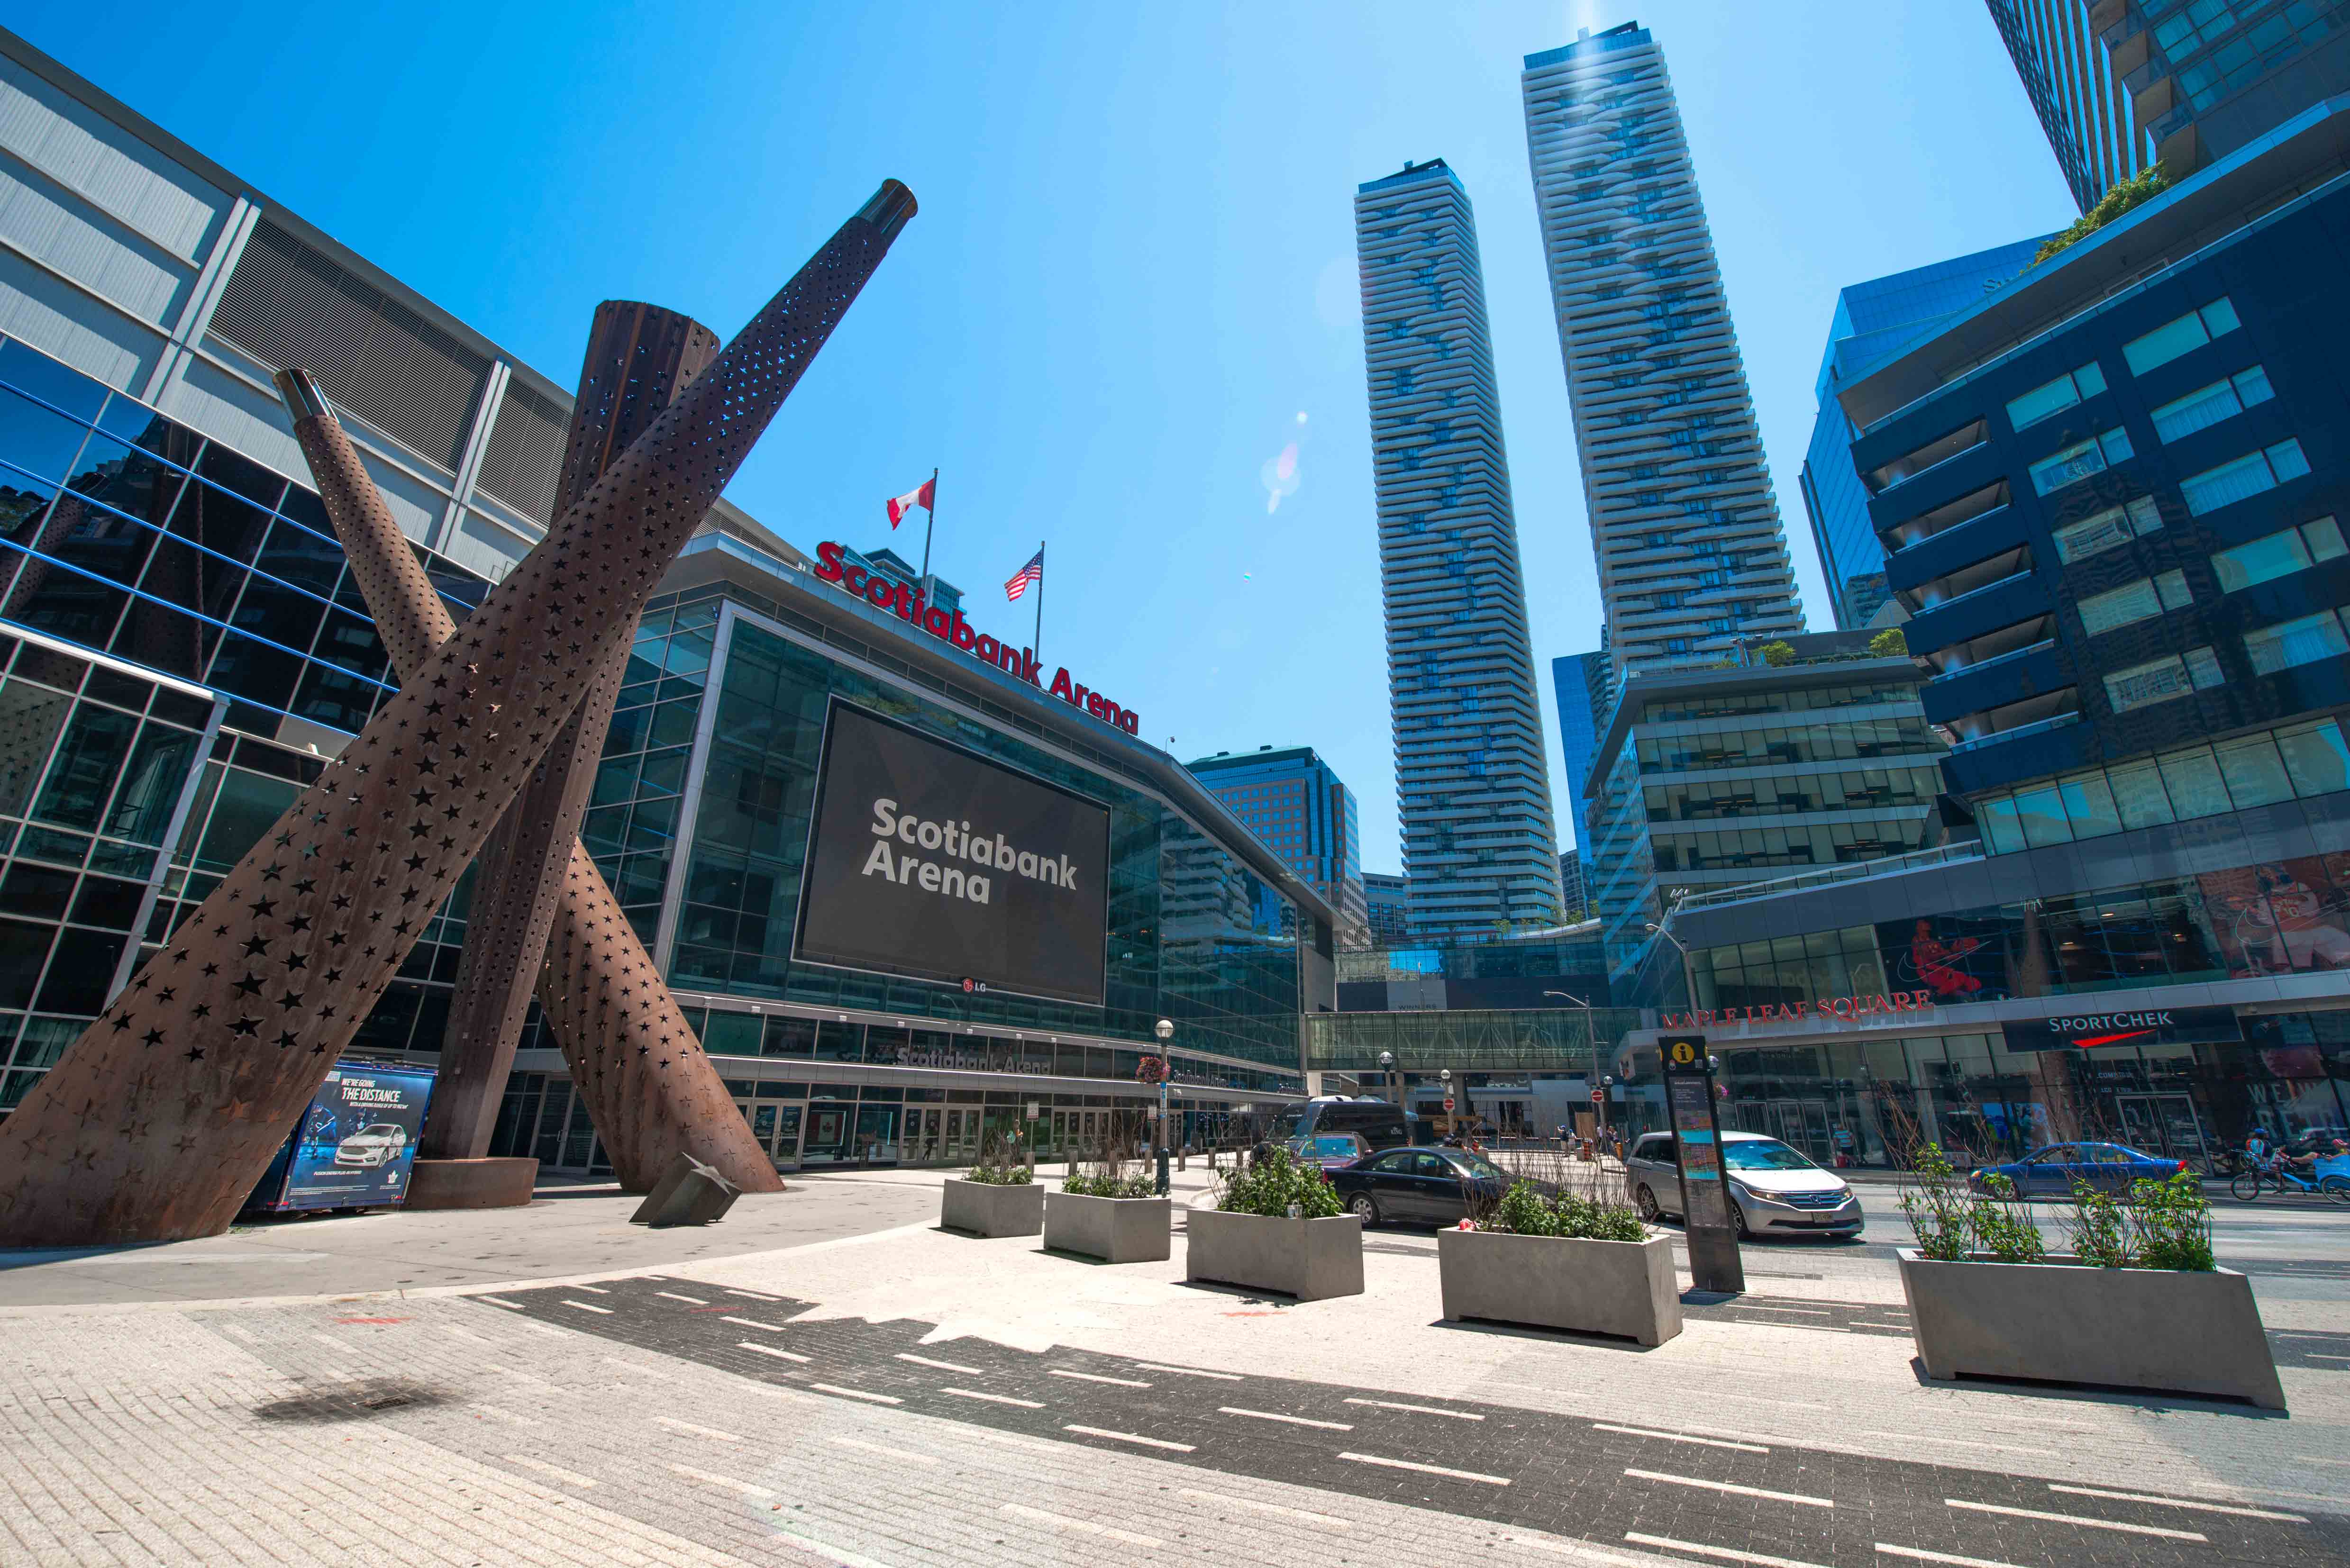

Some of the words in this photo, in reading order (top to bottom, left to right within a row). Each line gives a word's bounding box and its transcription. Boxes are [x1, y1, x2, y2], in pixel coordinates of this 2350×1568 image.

[813, 541, 1043, 689] Scotiabank
[1048, 667, 1139, 735] Arena
[871, 798, 1077, 890] Scotiabank
[862, 840, 990, 904] Arena
[975, 982, 986, 992] LG
[1661, 1008, 1739, 1032] MAPLE
[1744, 1001, 1809, 1024] LEAF
[1816, 989, 1934, 1022] SQUARE
[2048, 1011, 2175, 1032] SPORTCHEK
[896, 1047, 997, 1073] Scotiabank
[1002, 1055, 1051, 1075] Arena
[342, 1088, 360, 1100] THE
[359, 1089, 401, 1102] DISTANCE
[359, 1079, 376, 1088] GOING
